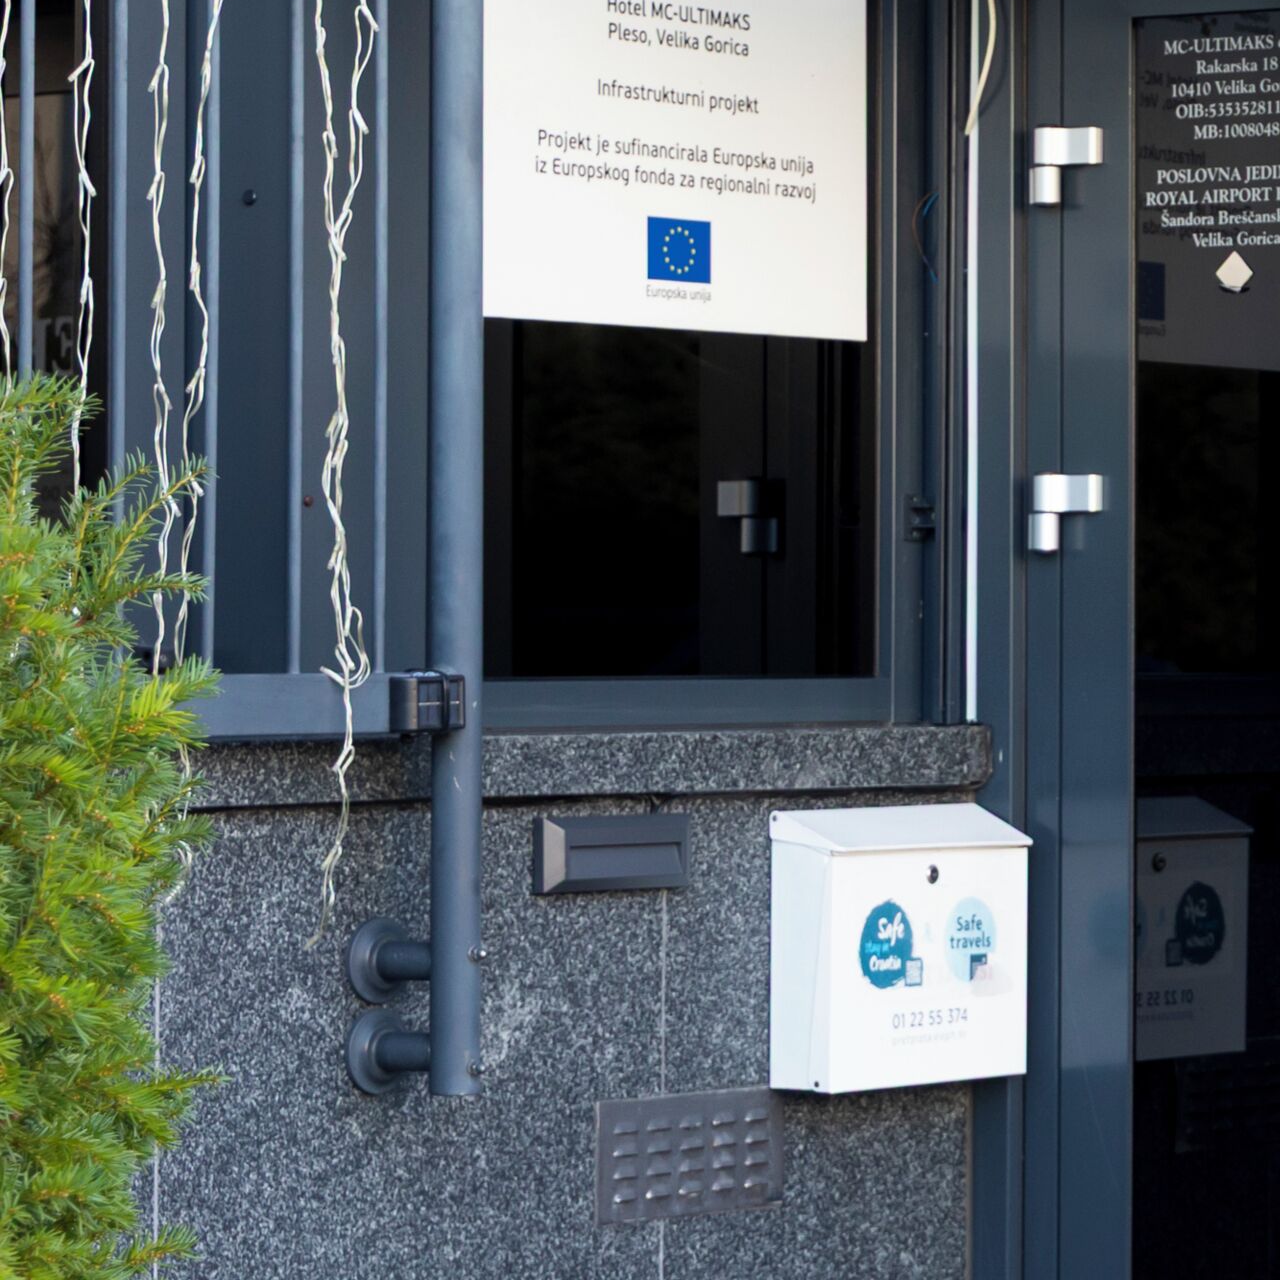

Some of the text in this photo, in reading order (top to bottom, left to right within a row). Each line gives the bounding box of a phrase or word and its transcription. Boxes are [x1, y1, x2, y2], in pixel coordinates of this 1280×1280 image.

[651, 1, 751, 31] MC-ULTIMAKS
[608, 22, 750, 57] Pleso, Velika Gorica
[1163, 34, 1274, 56] MC-ULTIMAKS
[1195, 56, 1279, 76] Rakarska 18
[597, 78, 759, 115] Infrastrukturni projekt
[1171, 81, 1212, 99] 10410
[1215, 79, 1257, 96] Velika
[1193, 121, 1280, 141] MB:1008048
[537, 128, 814, 175] Projekt je sufinancirala Europska unija
[535, 157, 817, 204] iz Europskog fonda za regionalni razvoj
[1156, 167, 1242, 185] POSLOVNA
[1145, 189, 1199, 207] ROYAL
[1201, 186, 1273, 204] AIRPORT
[1160, 209, 1215, 228] Šandora
[1192, 231, 1234, 249] Velika
[646, 284, 712, 304] Europska unija
[878, 912, 905, 946] Safe
[956, 914, 983, 932] Safe
[950, 931, 992, 950] travels
[892, 1007, 968, 1030] 01 22 55 374
